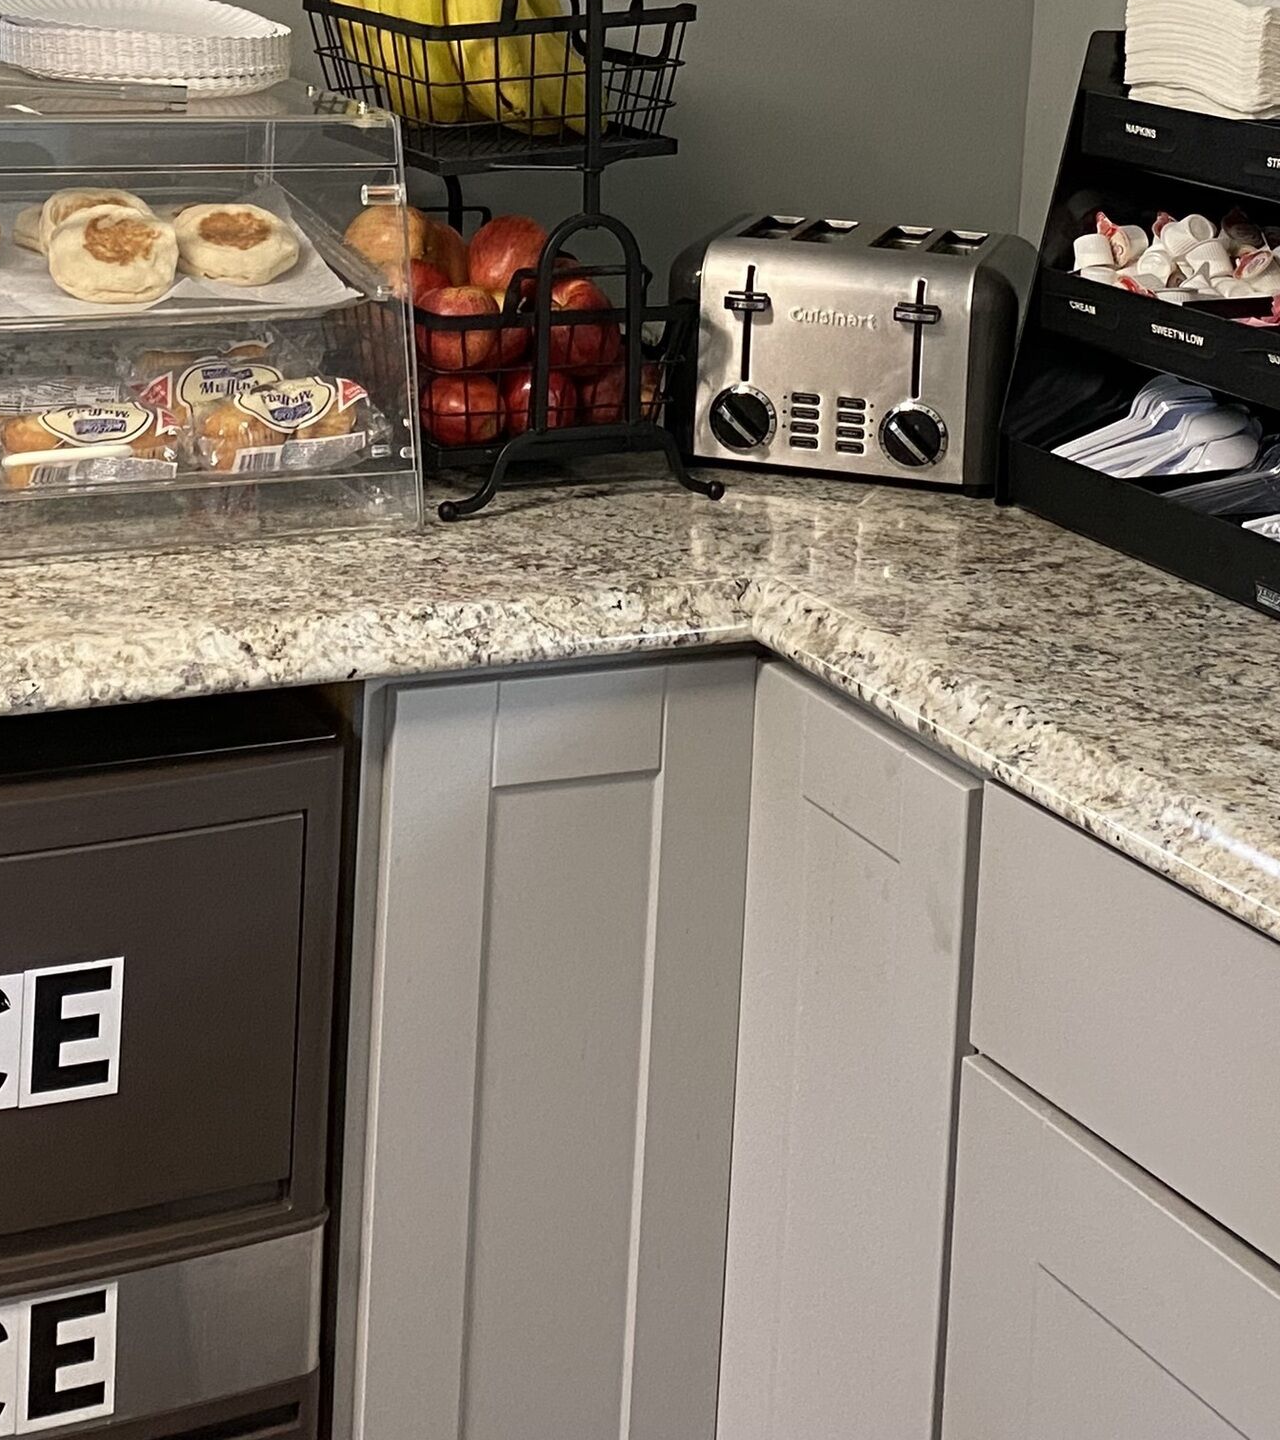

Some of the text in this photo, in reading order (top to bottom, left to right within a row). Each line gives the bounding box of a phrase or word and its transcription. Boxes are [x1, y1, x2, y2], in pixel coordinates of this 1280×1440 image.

[1125, 122, 1157, 140] NAPKINS
[1069, 300, 1097, 316] CREAM
[790, 308, 878, 330] Cuisinart
[1185, 333, 1205, 348] LOW
